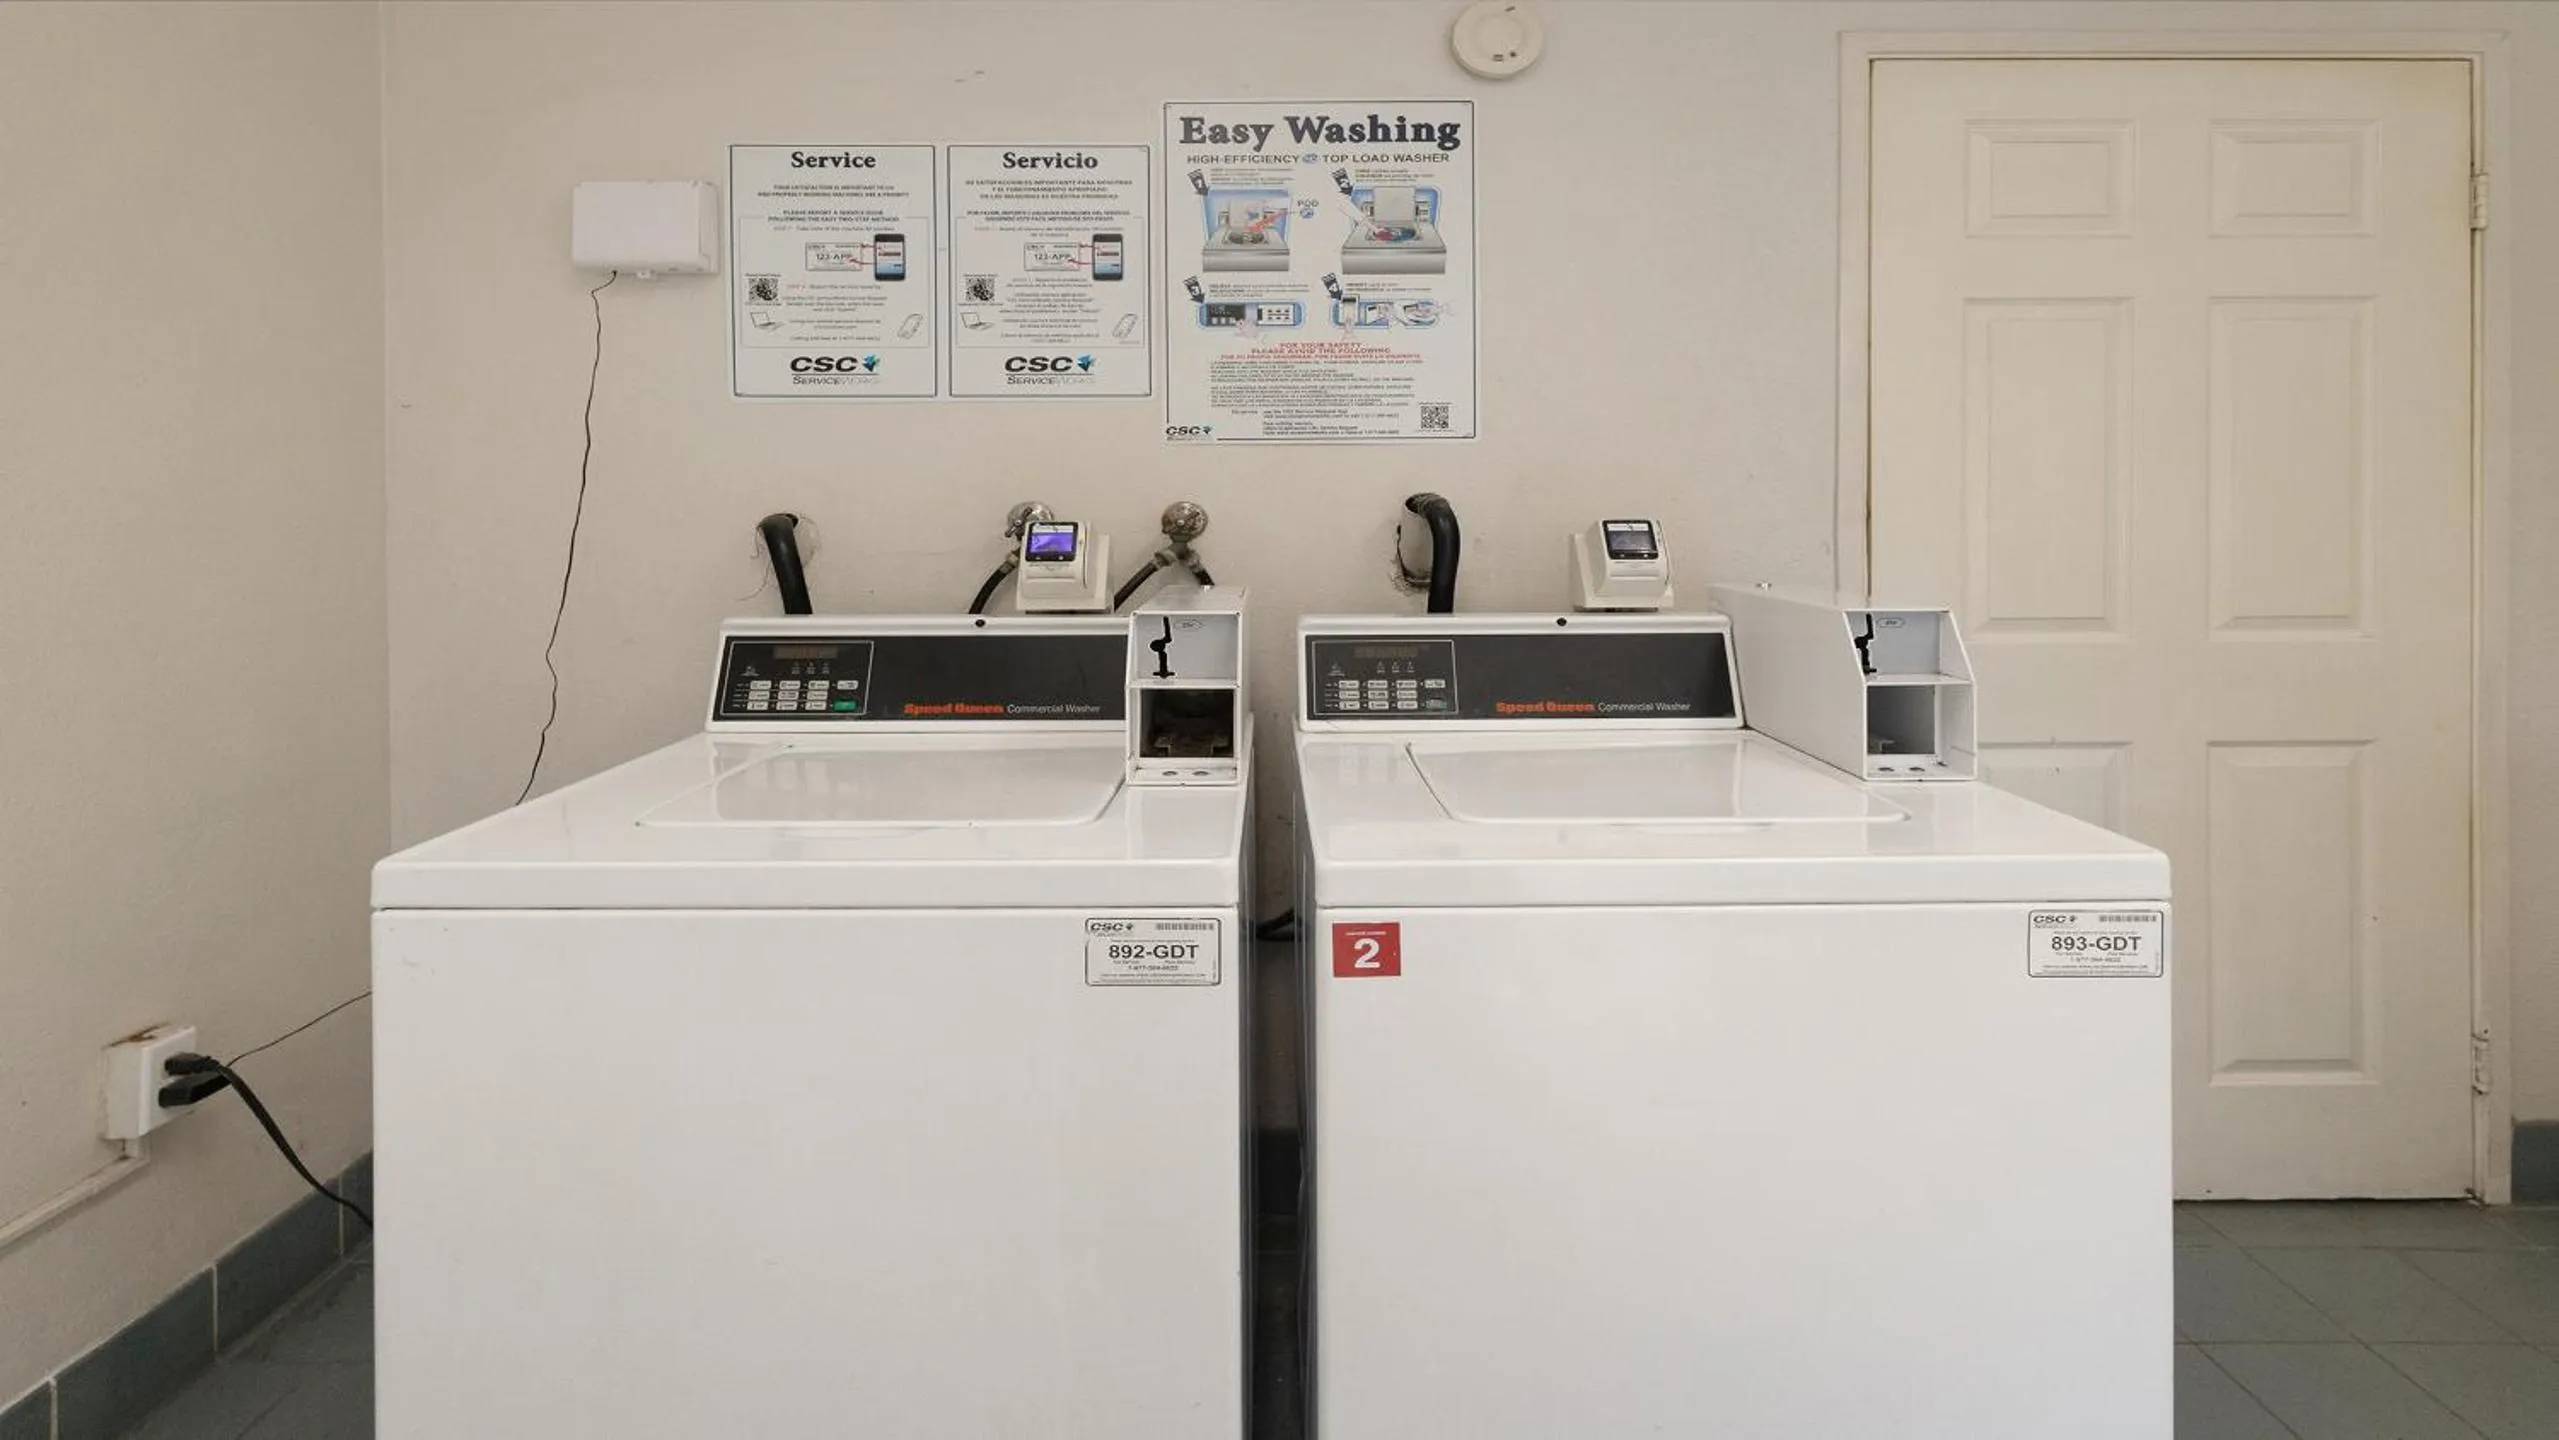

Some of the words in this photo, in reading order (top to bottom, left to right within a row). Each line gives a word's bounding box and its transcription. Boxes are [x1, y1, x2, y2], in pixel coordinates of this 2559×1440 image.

[1179, 116, 1274, 152] Easy
[1284, 113, 1462, 151] Washing
[790, 151, 876, 168] Service
[1002, 151, 1099, 169] Servicio
[1322, 153, 1349, 163] TOP
[1352, 153, 1390, 163] LOAD
[1393, 152, 1451, 163] WASHER
[789, 356, 859, 373] CSC
[1004, 356, 1074, 373] CSC
[1166, 425, 1202, 436] CSC
[1006, 703, 1064, 714] Commercial
[1064, 703, 1101, 714] Washer
[1598, 702, 1654, 713] Commercial
[1656, 702, 1693, 713] Washer
[2032, 914, 2067, 924] CSC
[1090, 922, 1124, 932] CSC
[2051, 935, 2142, 951] 893-GDT
[1108, 944, 1199, 959] 892-GDT
[1354, 938, 1380, 968] 2
